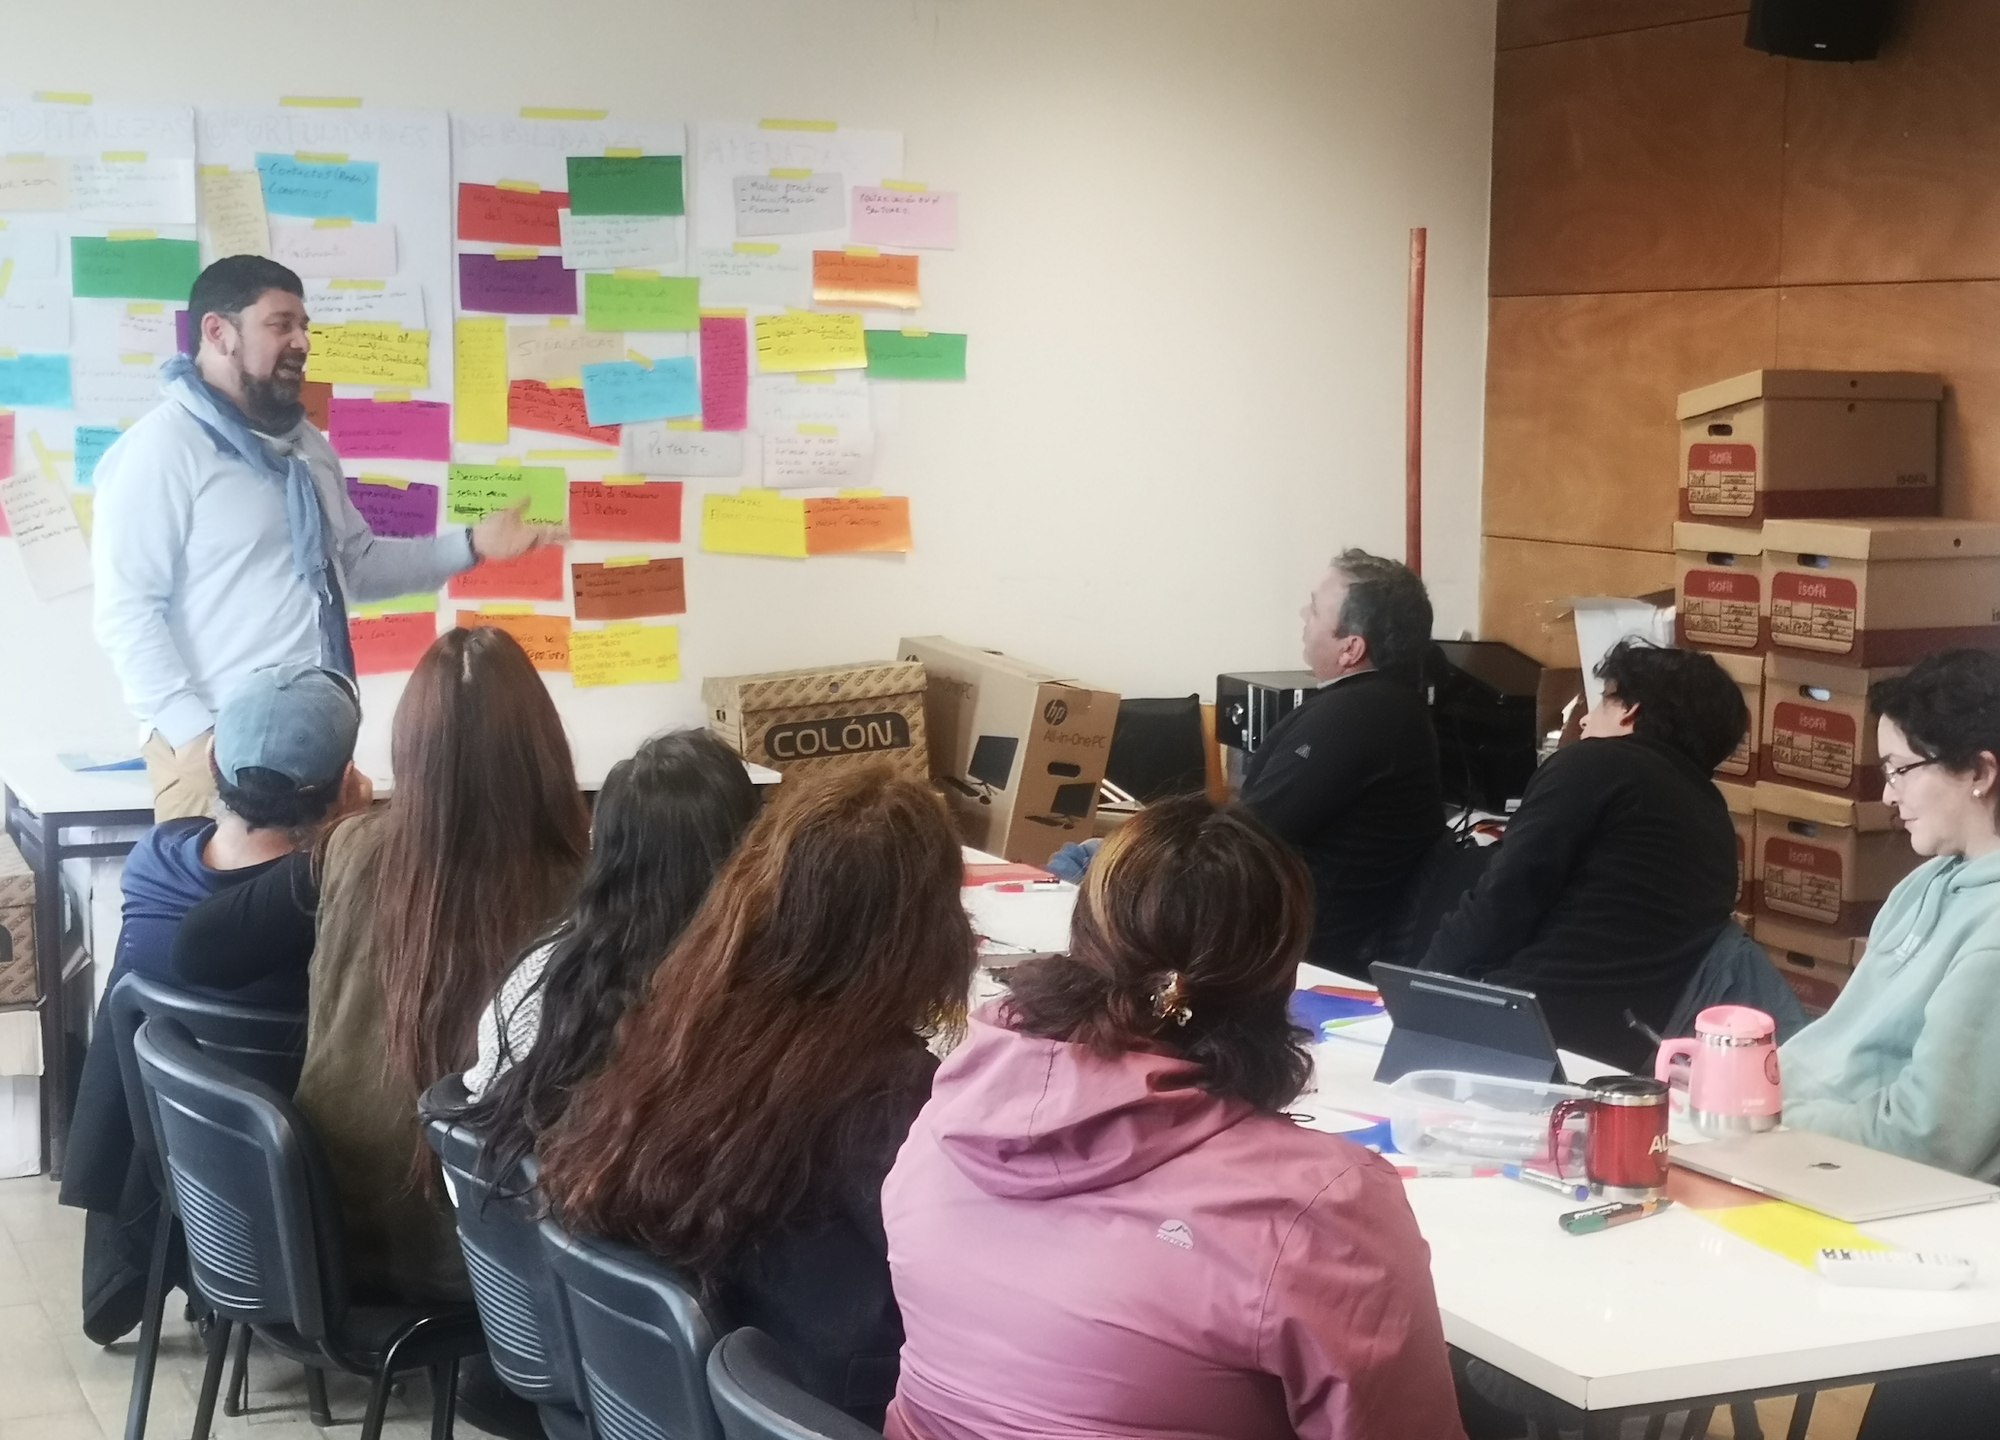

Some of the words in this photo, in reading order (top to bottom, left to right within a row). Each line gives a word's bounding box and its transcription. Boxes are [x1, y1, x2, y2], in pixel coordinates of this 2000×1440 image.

[1708, 578, 1734, 594] isofit
[1798, 580, 1828, 599] isofit
[1046, 700, 1065, 725] hp
[1799, 712, 1827, 731] isofit
[773, 717, 893, 758] COLÓN
